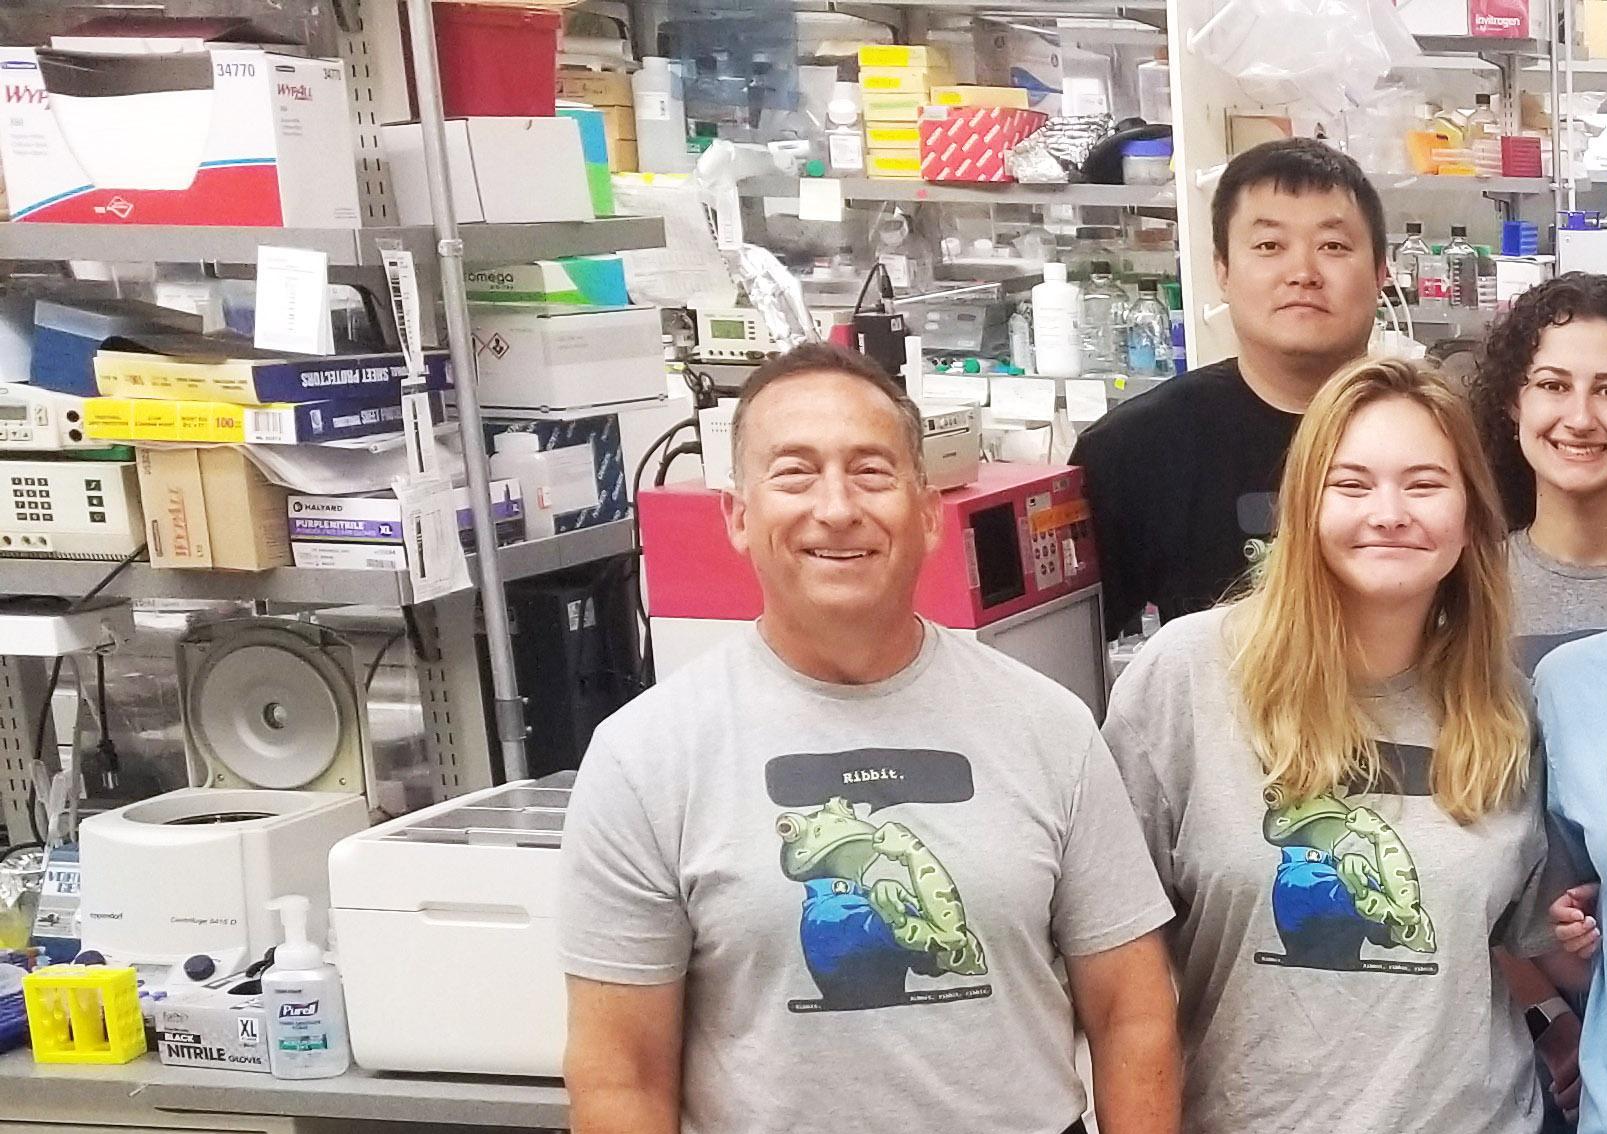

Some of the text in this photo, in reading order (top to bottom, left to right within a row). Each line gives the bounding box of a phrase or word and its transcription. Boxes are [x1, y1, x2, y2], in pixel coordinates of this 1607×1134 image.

[1475, 14, 1521, 29] invitrogen
[217, 63, 255, 78] 34770
[216, 417, 234, 429] 100
[304, 504, 343, 512] HALYARD
[379, 524, 393, 536] XL
[842, 768, 905, 784] Ribbit.
[283, 1003, 316, 1016] Purell
[240, 1019, 258, 1038] XL
[164, 1033, 194, 1043] BLACK
[167, 1043, 262, 1065] NITRILE GLOVES
